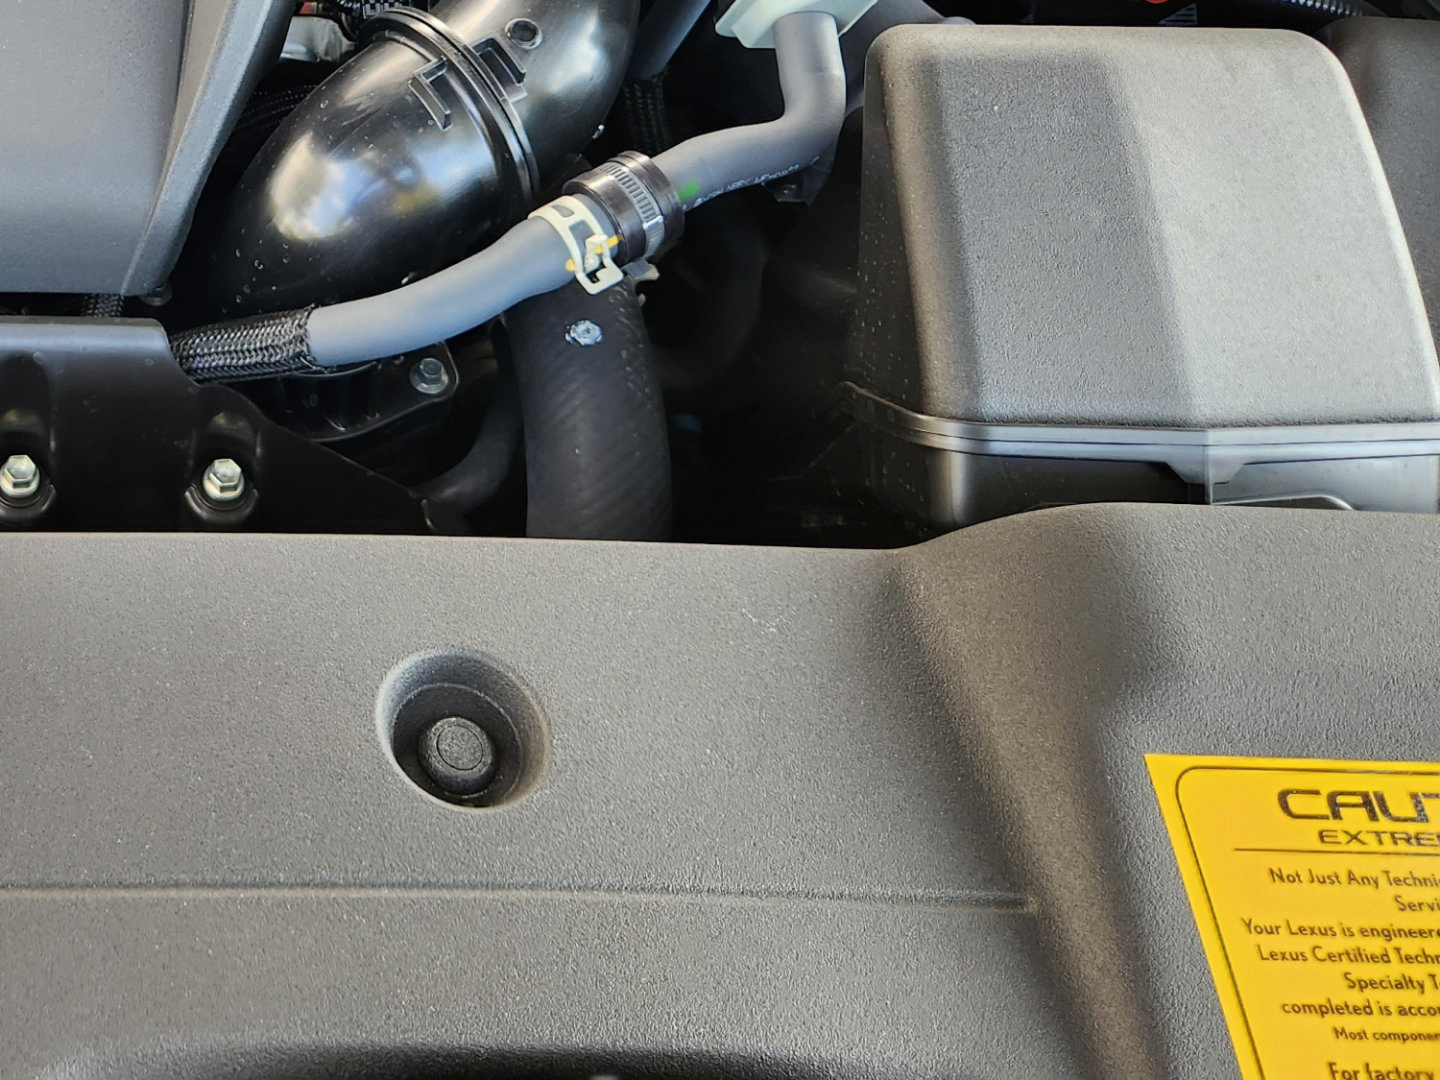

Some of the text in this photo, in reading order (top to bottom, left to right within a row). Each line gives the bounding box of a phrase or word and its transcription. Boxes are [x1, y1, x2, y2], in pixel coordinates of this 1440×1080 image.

[1318, 829, 1440, 847] EXTRE
[1269, 868, 1303, 883] Not
[1308, 869, 1342, 885] Just
[1348, 870, 1379, 889] Any
[1242, 918, 1281, 935] Your
[1286, 919, 1337, 936] Lexus
[1340, 922, 1355, 937] is
[1257, 944, 1309, 961] Lexus
[1312, 945, 1391, 964] Certified
[1344, 972, 1425, 994] Specialty
[1281, 998, 1374, 1019] completed
[1377, 1001, 1392, 1016] is
[1334, 1026, 1369, 1041] Most
[1328, 1062, 1435, 1080] For factory
